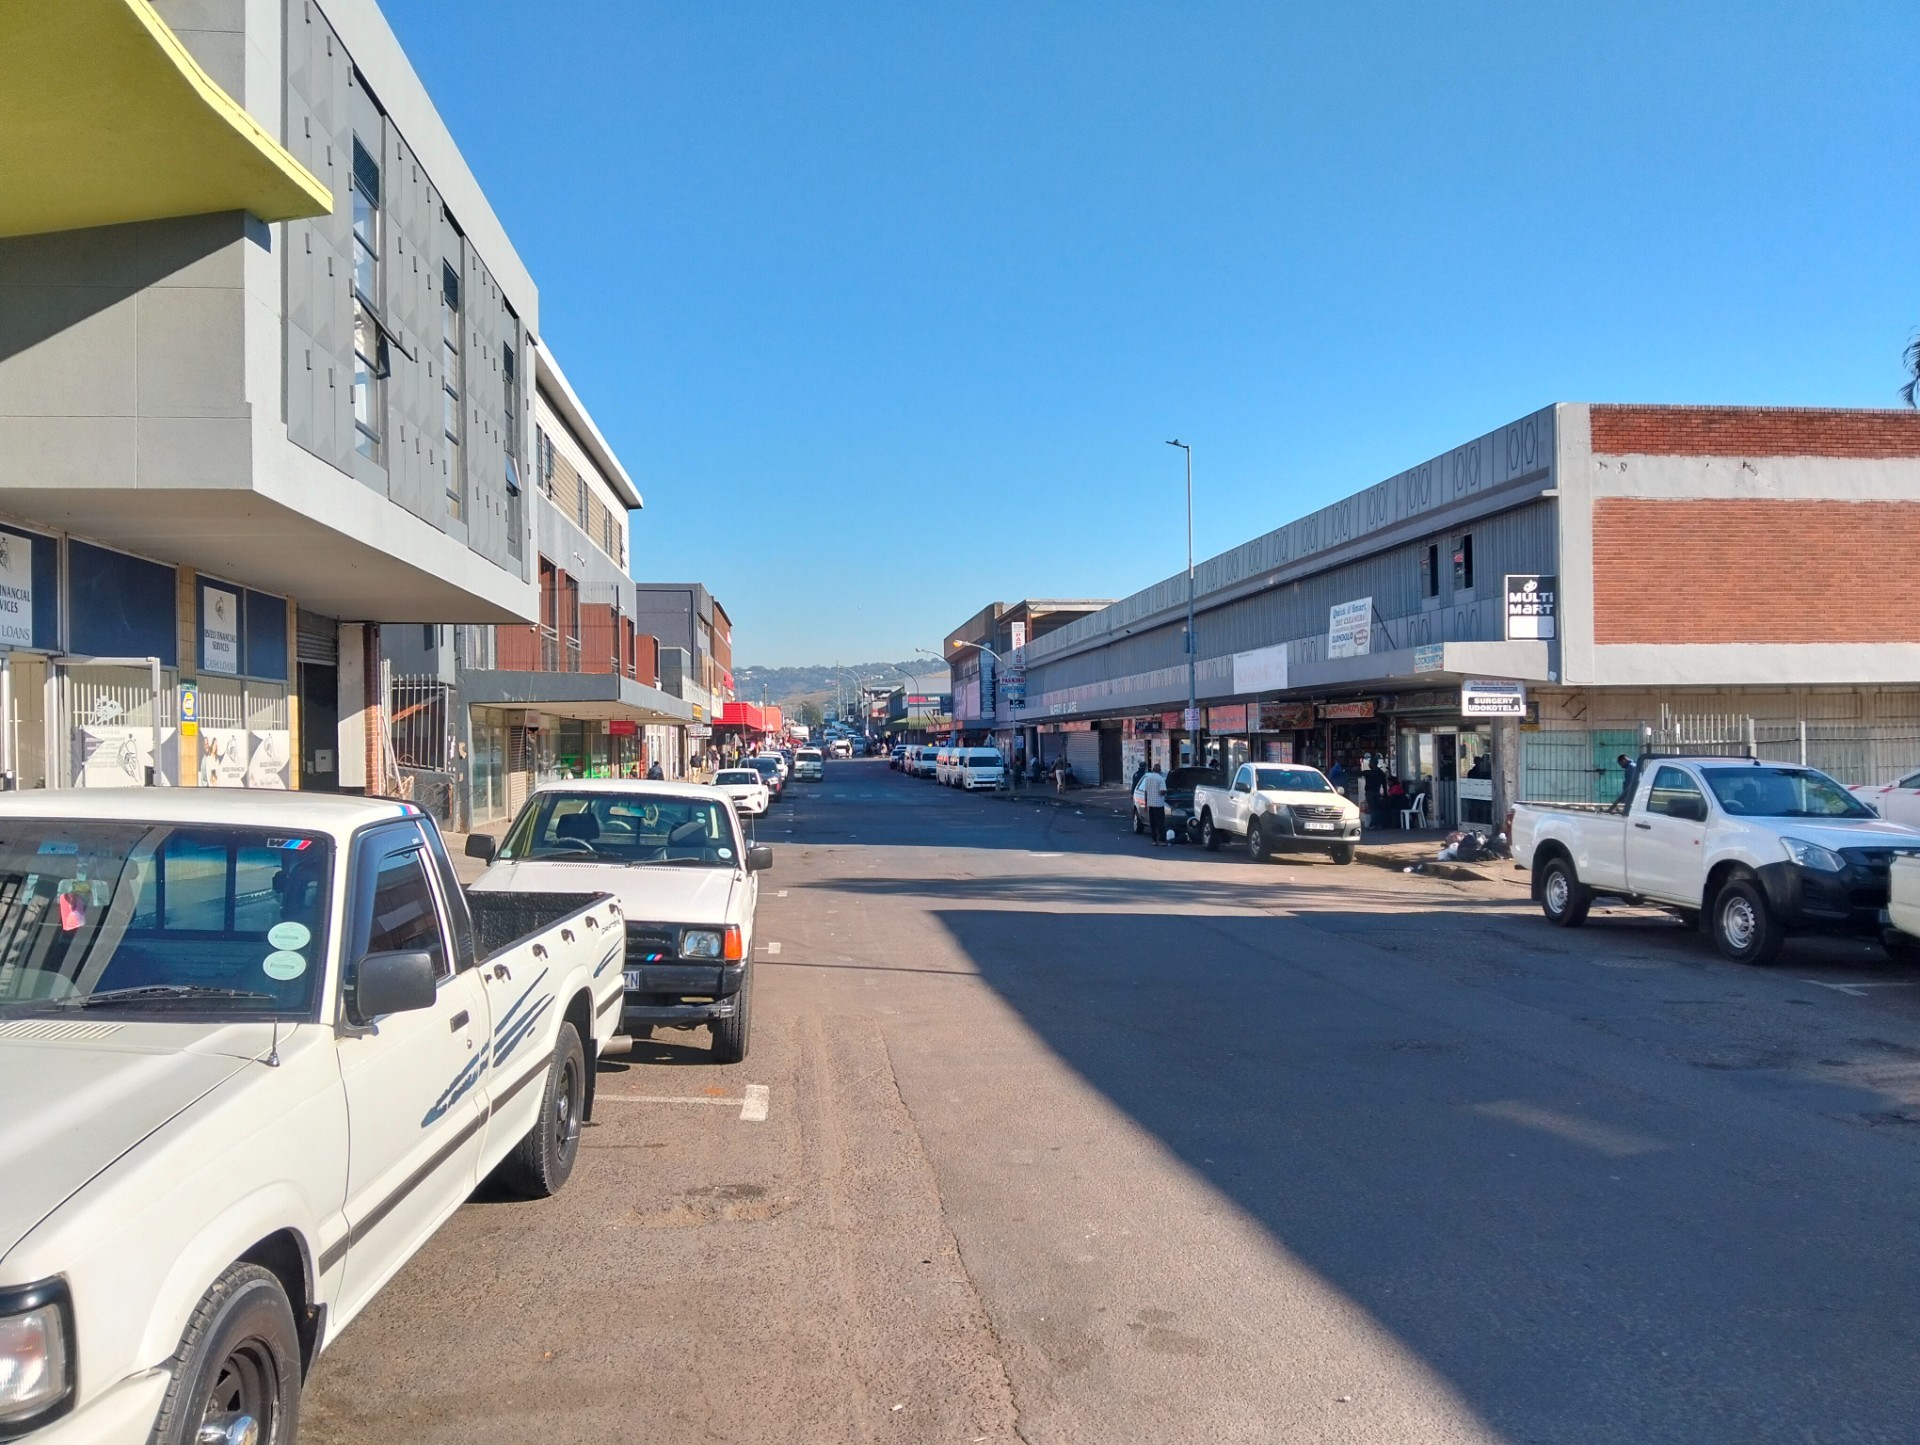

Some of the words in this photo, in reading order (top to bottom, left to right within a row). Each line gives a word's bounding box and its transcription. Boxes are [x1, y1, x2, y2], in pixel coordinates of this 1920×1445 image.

[1, 624, 30, 640] LOANS
[212, 640, 230, 652] SERVICES
[205, 657, 219, 669] CASH
[219, 660, 236, 672] LOANS
